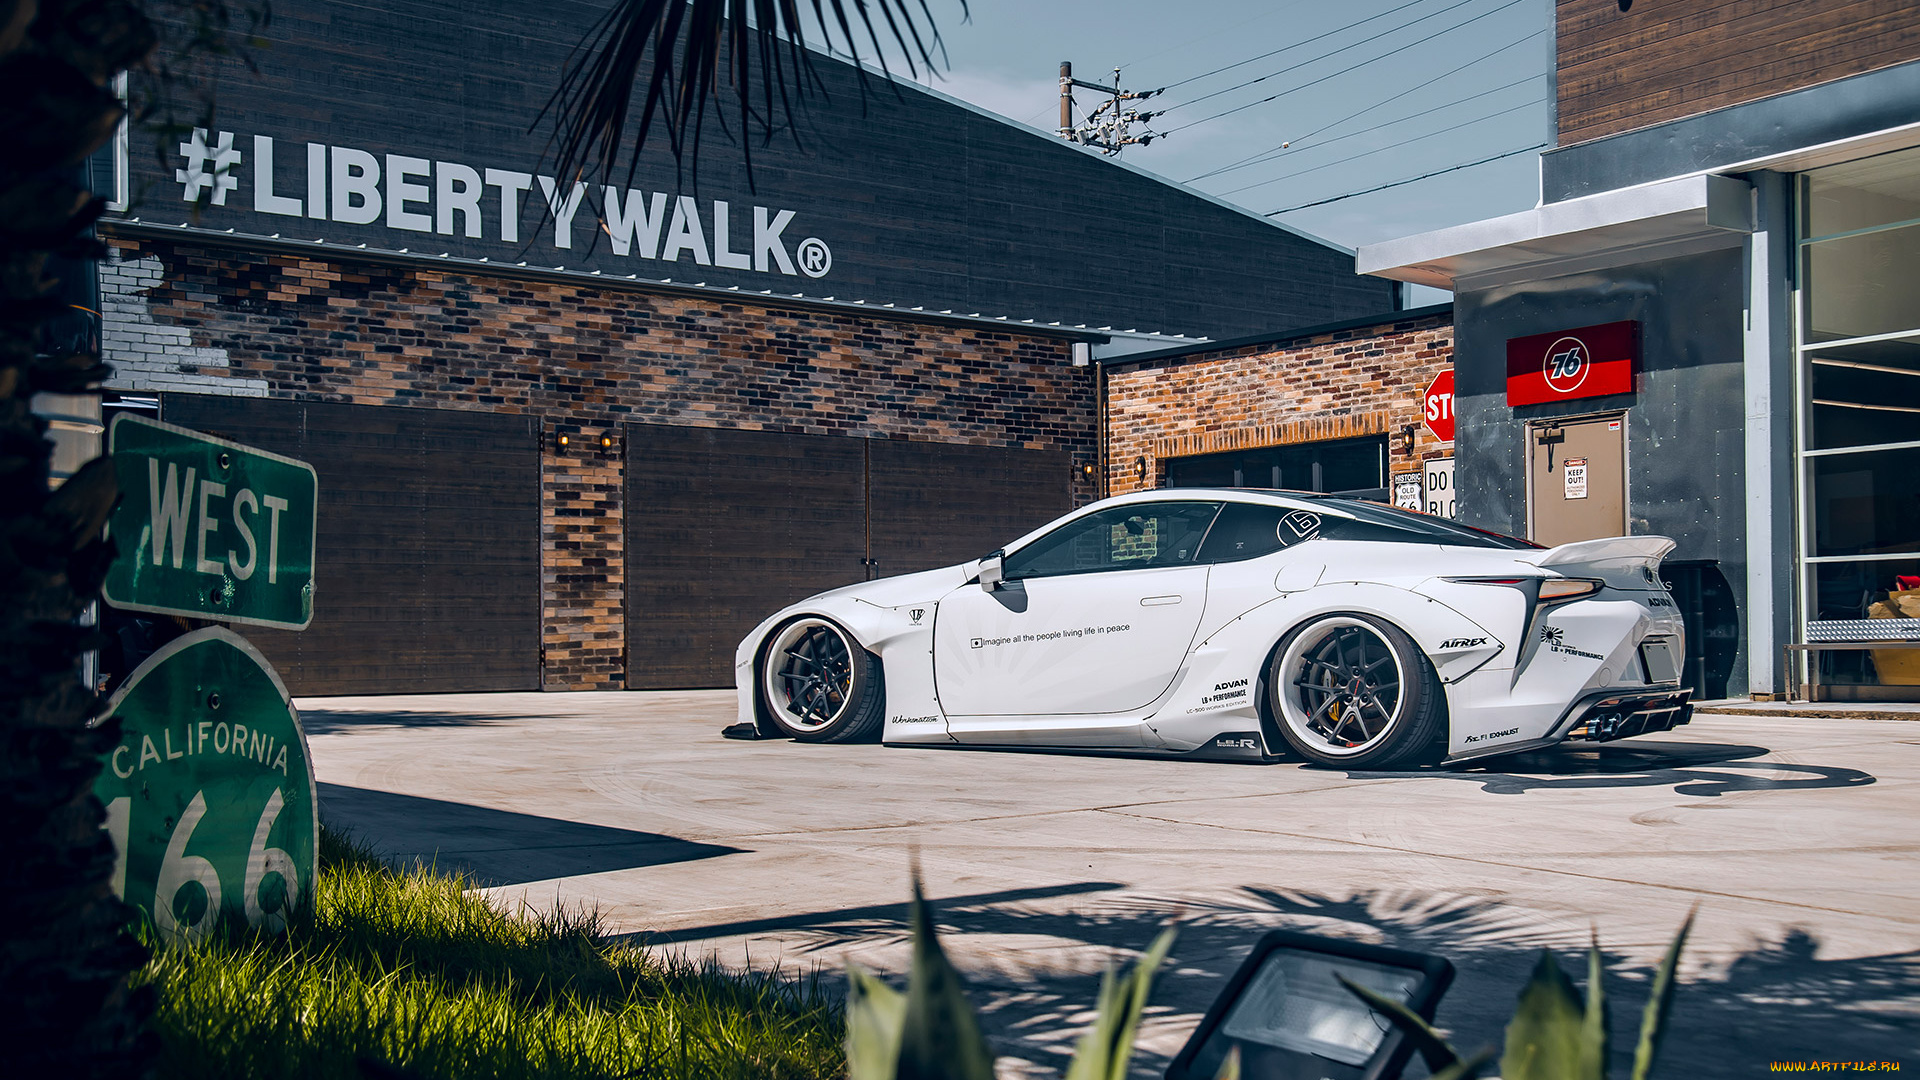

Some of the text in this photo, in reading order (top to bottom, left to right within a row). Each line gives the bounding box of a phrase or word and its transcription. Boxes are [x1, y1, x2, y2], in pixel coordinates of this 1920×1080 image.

[1550, 346, 1581, 379] 76
[1426, 393, 1455, 421] ST
[1395, 473, 1421, 483] HISTORIC
[1429, 471, 1447, 491] DO
[1567, 469, 1584, 477] KEEP
[1567, 477, 1584, 485] OUT!
[148, 457, 288, 585] WEST
[983, 624, 1130, 647] Imagine all the people living life in peace
[1564, 648, 1604, 660] PERFORMANCE
[1214, 678, 1248, 691] ADVAN
[1213, 689, 1247, 702] PERFORMANCE
[1226, 700, 1247, 708] EDITION
[112, 721, 288, 780] CALIFORNIA
[98, 787, 299, 945] 166
